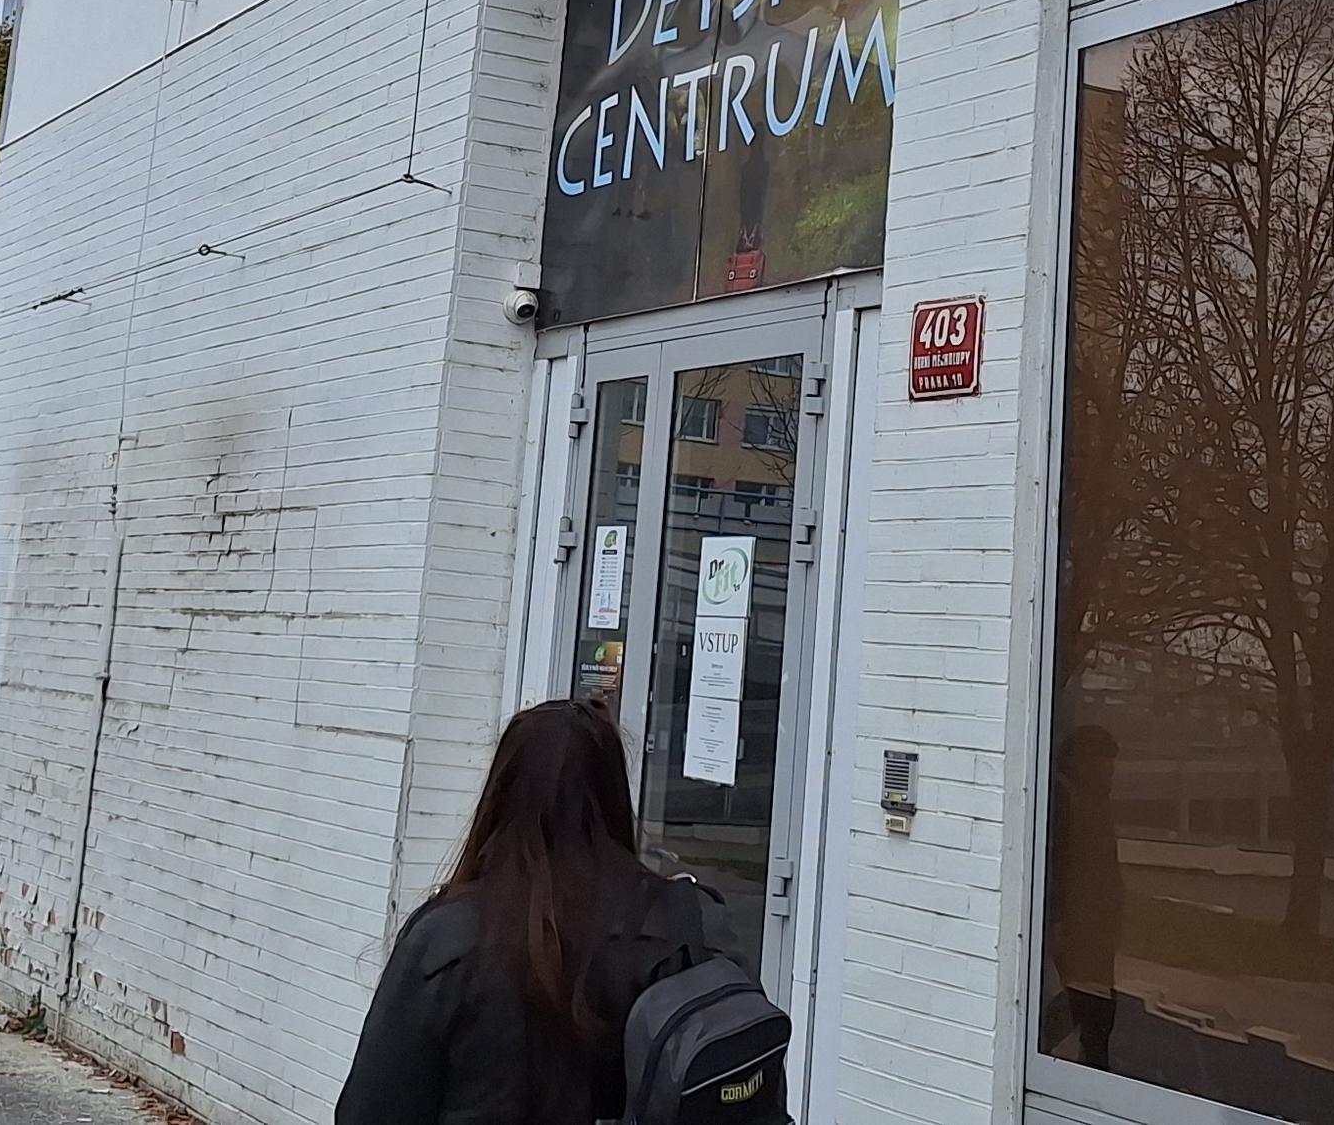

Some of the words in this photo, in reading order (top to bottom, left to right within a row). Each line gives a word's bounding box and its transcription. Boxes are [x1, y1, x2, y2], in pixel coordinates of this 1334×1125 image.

[555, 7, 896, 198] CENTRUM
[919, 306, 968, 349] 403
[918, 374, 949, 390] PRAHA
[951, 373, 963, 387] 10
[708, 558, 725, 581] Dr
[698, 632, 739, 654] VSTUP
